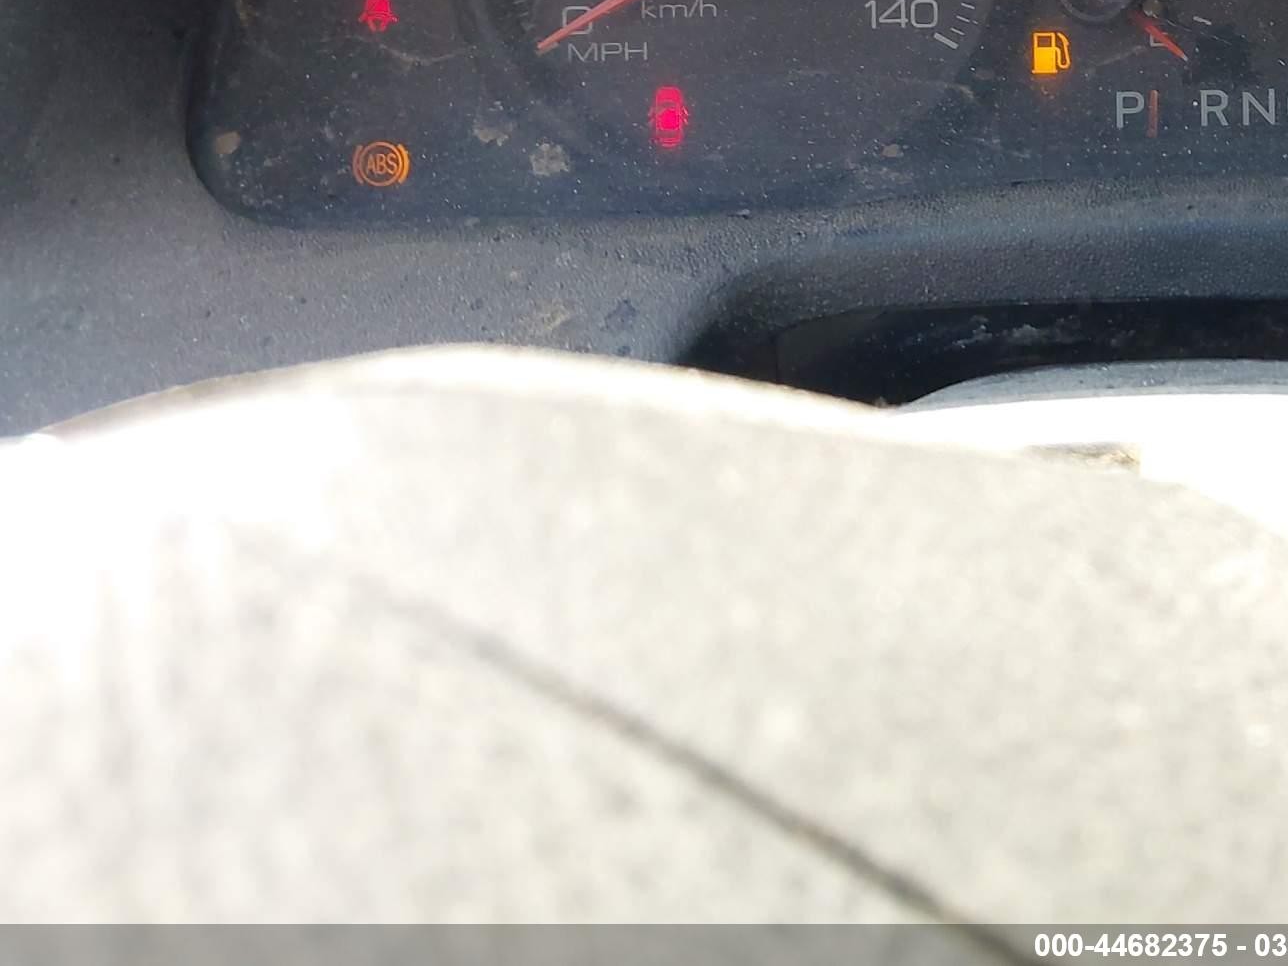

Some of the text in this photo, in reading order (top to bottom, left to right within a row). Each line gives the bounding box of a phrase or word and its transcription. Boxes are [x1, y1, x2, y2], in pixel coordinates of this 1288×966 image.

[641, 0, 717, 18] km/h
[865, 0, 938, 28] 140
[568, 42, 648, 62] MPH
[1116, 91, 1144, 128] P
[1200, 89, 1228, 127] R
[1242, 89, 1275, 126] N
[367, 153, 398, 176] ABS
